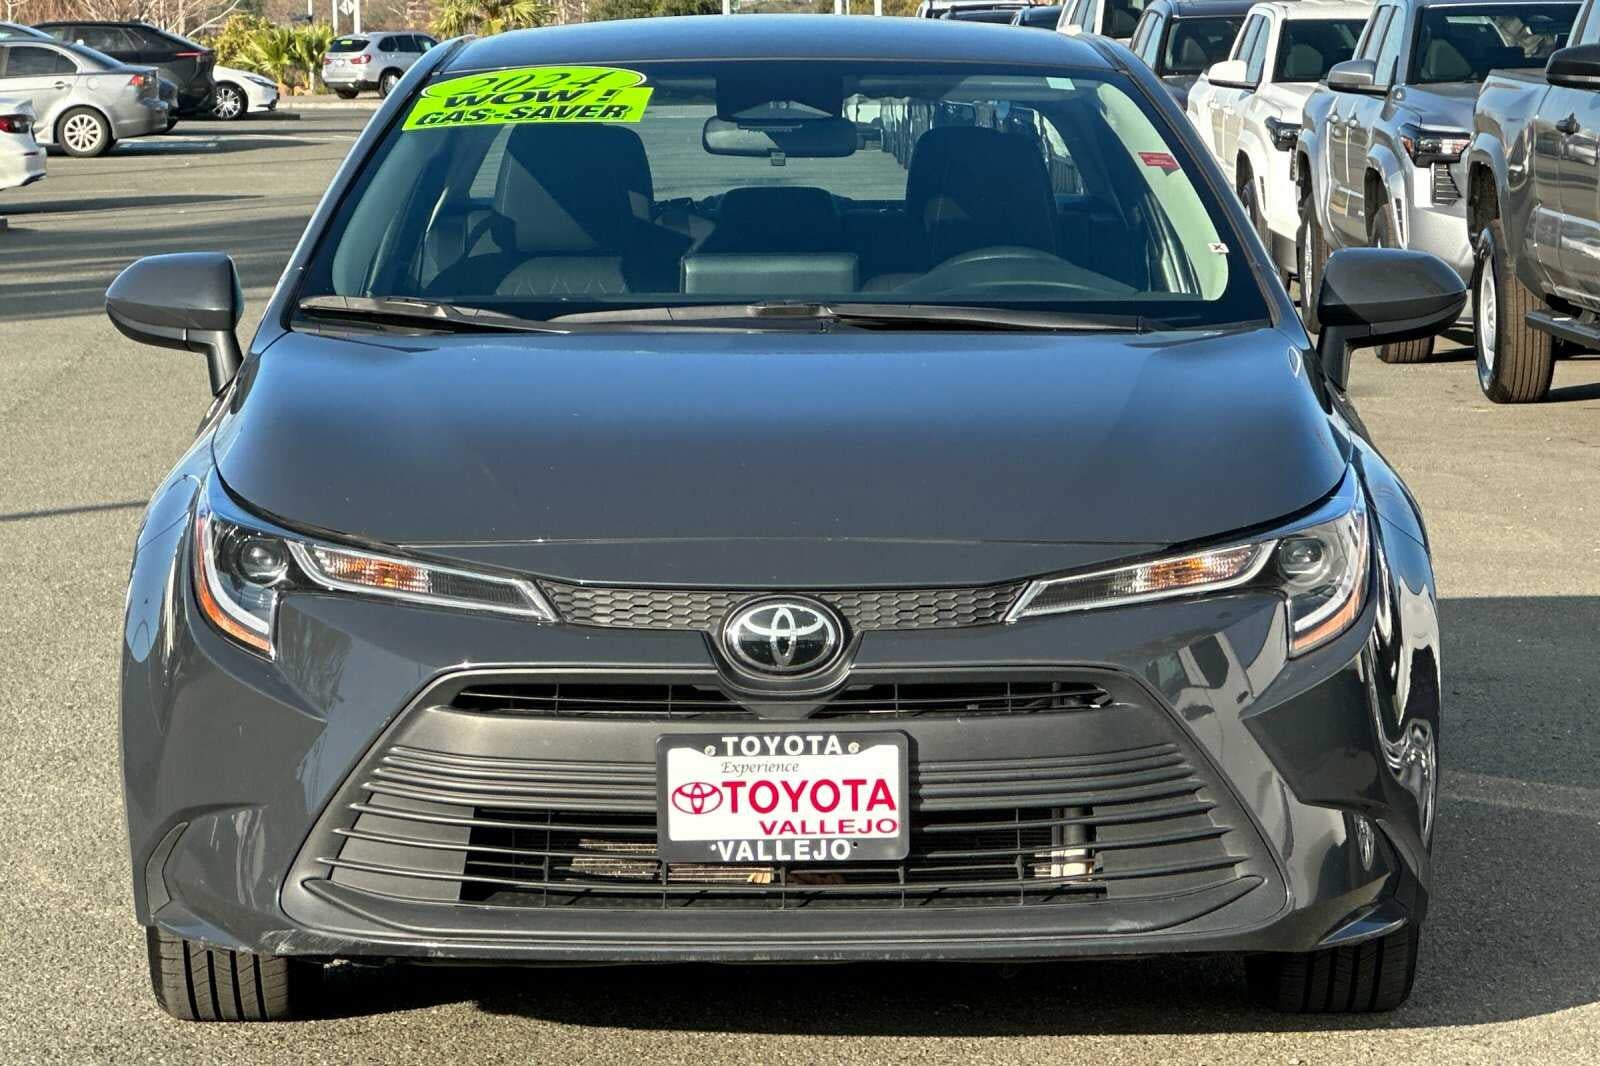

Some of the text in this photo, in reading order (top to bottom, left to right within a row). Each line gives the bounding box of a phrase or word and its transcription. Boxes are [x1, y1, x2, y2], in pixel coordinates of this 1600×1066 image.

[454, 73, 616, 96] 2024
[415, 104, 630, 126] GAS-SAVER
[722, 735, 843, 756] TOYOTA
[720, 760, 800, 777] Experience
[722, 779, 897, 814] TOYOTA
[758, 818, 898, 836] VALLEJO
[716, 839, 852, 861] VALLEJO
